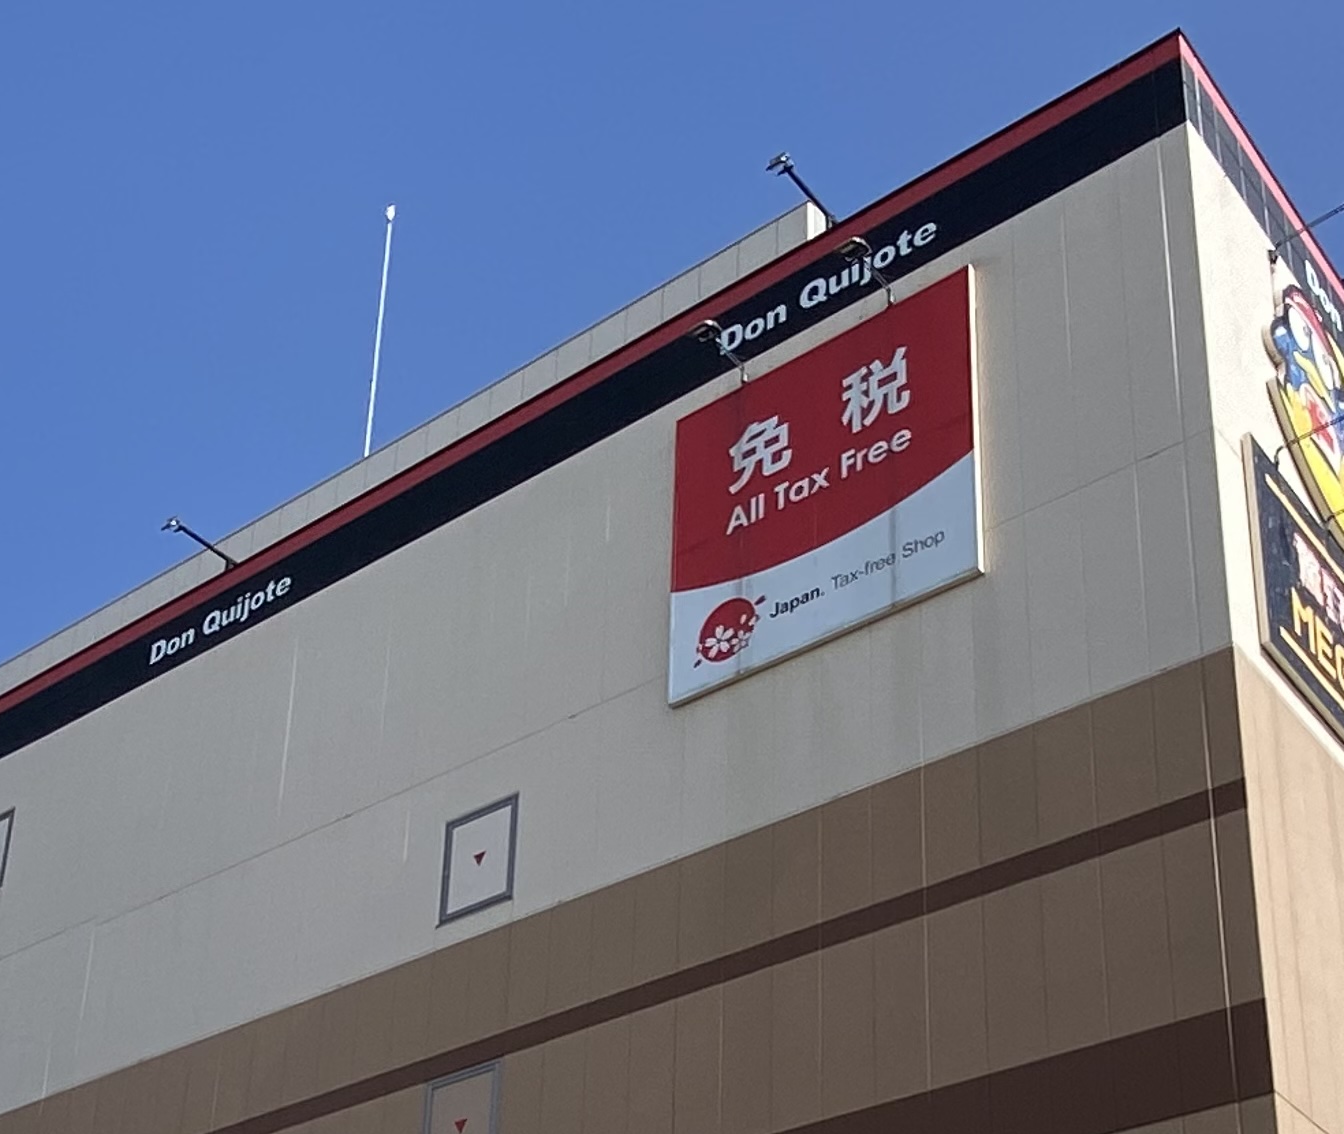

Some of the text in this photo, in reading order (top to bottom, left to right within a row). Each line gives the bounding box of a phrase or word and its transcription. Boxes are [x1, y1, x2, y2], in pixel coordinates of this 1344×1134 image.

[719, 222, 937, 355] Don Quijote
[1305, 260, 1342, 332] Don
[729, 346, 910, 494] 免税
[726, 429, 912, 535] All Tax Free
[830, 553, 896, 590] Tax-free
[902, 530, 945, 558] Shop
[149, 577, 291, 665] Don Quijote
